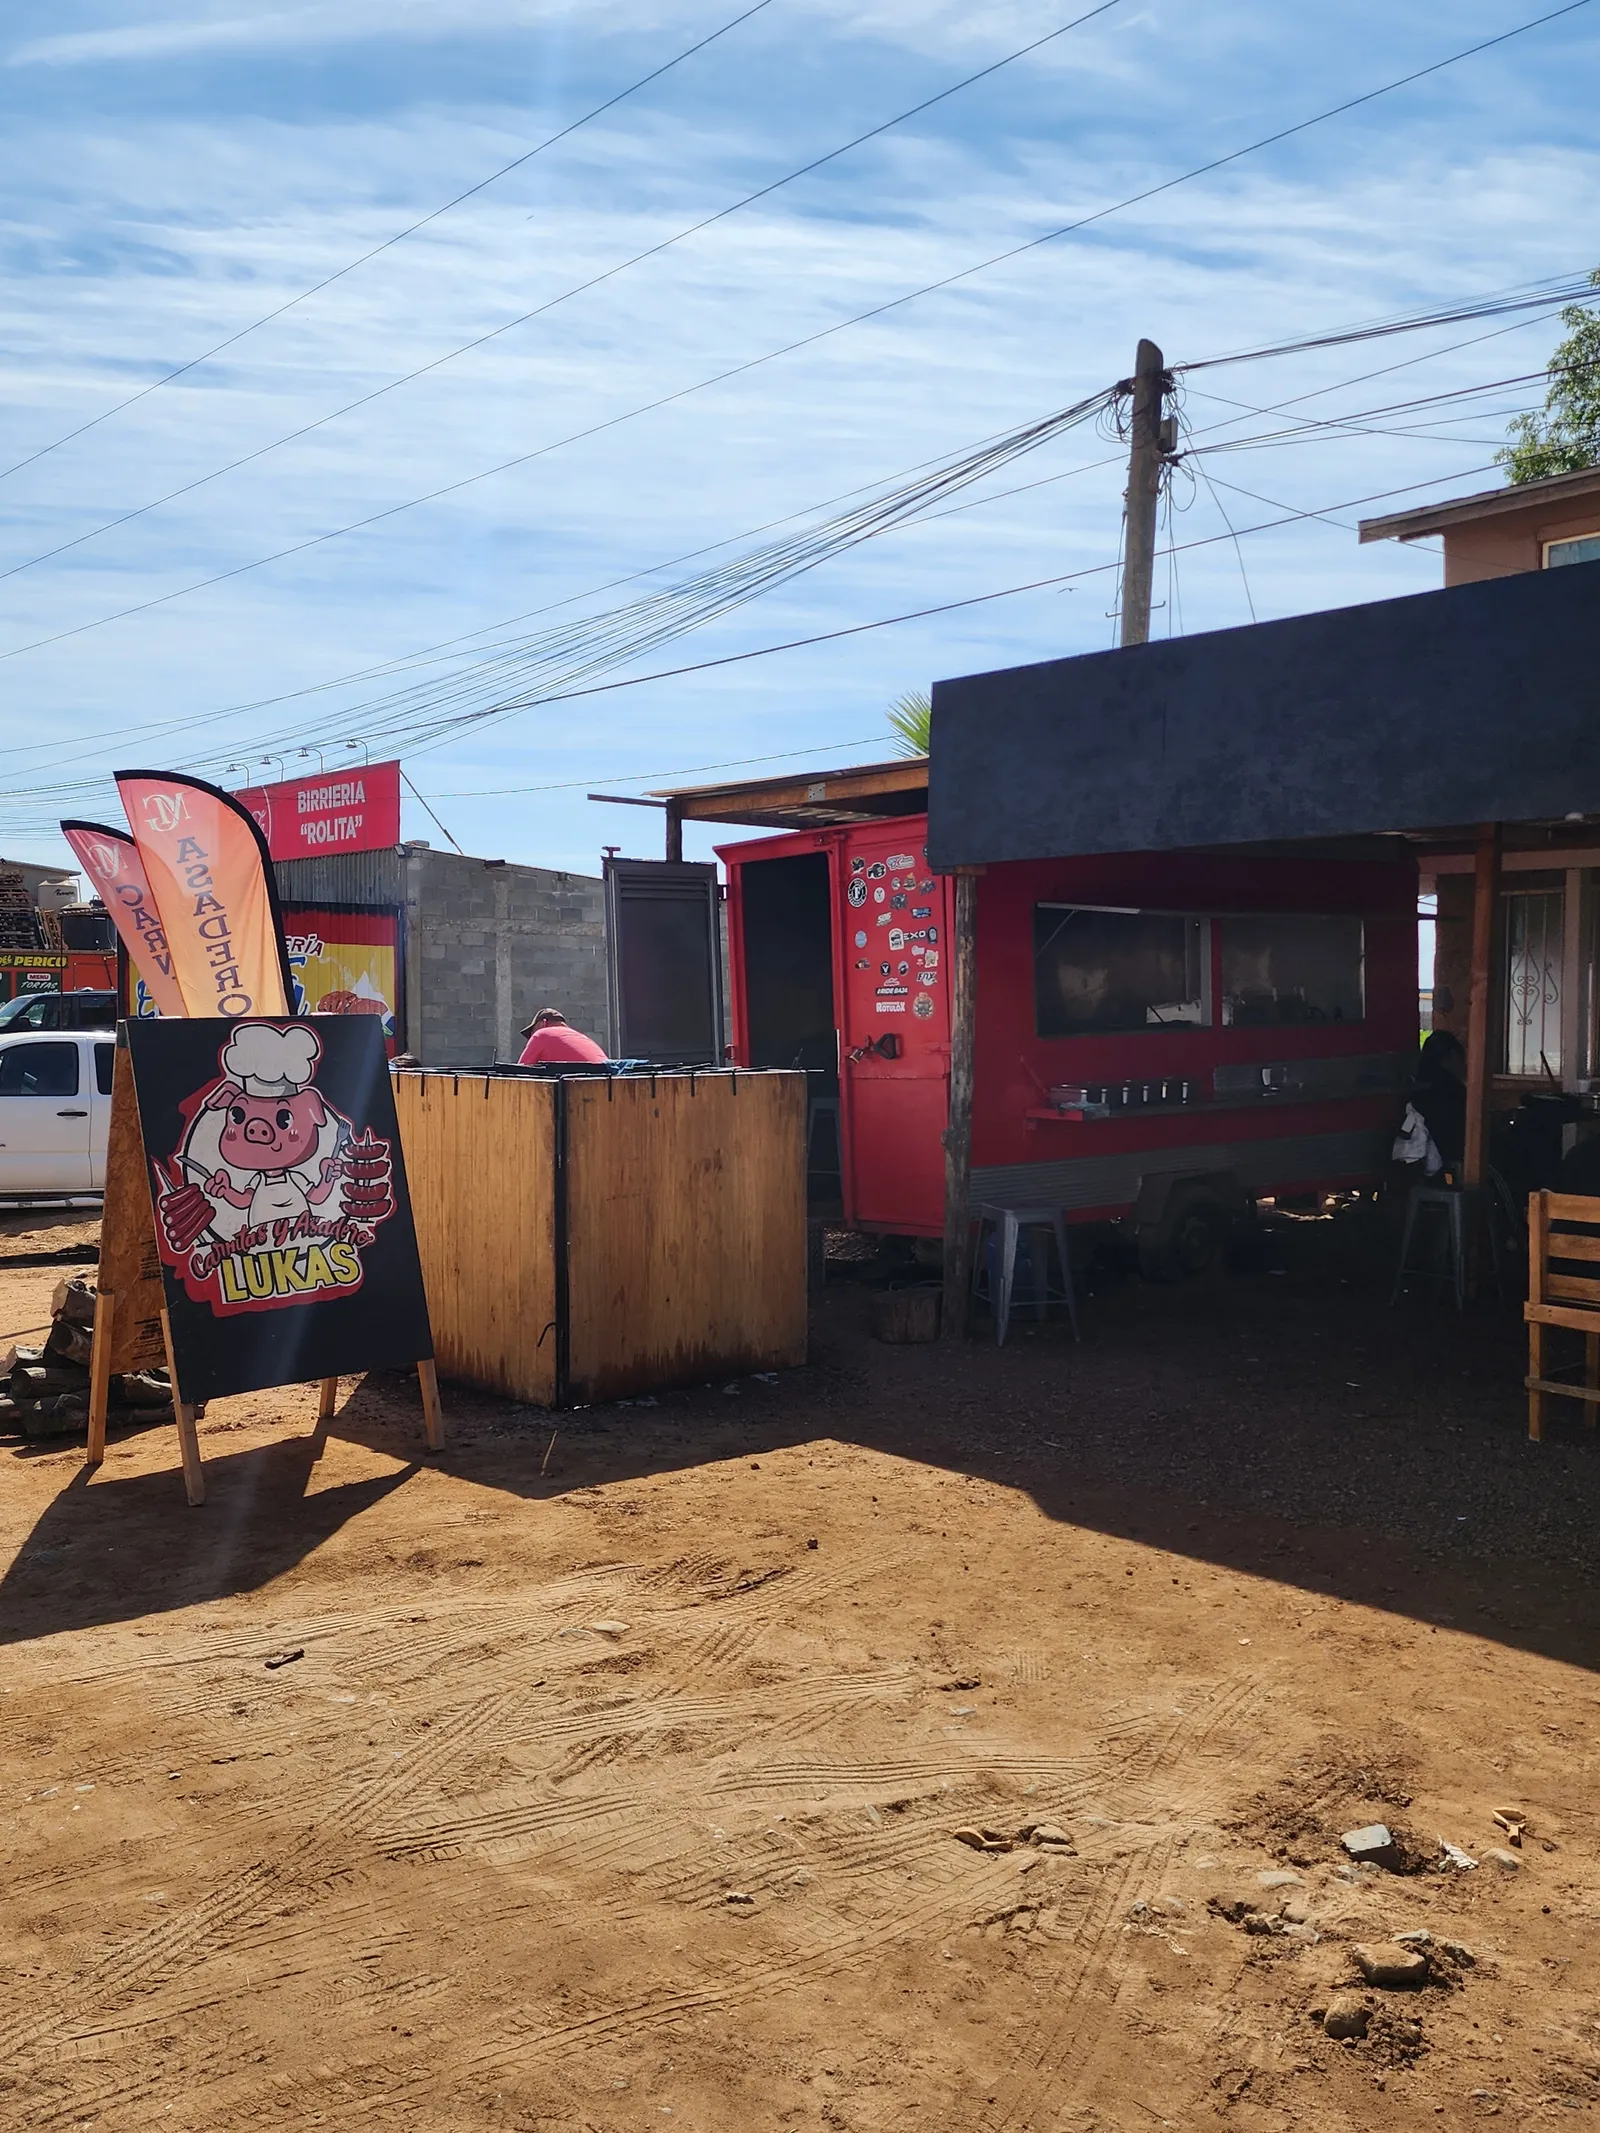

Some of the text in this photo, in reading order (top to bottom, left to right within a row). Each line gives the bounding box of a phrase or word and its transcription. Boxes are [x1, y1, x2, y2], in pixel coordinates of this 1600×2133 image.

[297, 781, 366, 814] BIRRIERIA
[13, 956, 67, 967] PERICO
[20, 981, 58, 989] TORTAS
[190, 1223, 268, 1279] Carnitas
[288, 1210, 375, 1248] Asadero
[221, 1243, 361, 1303] LUKAS
